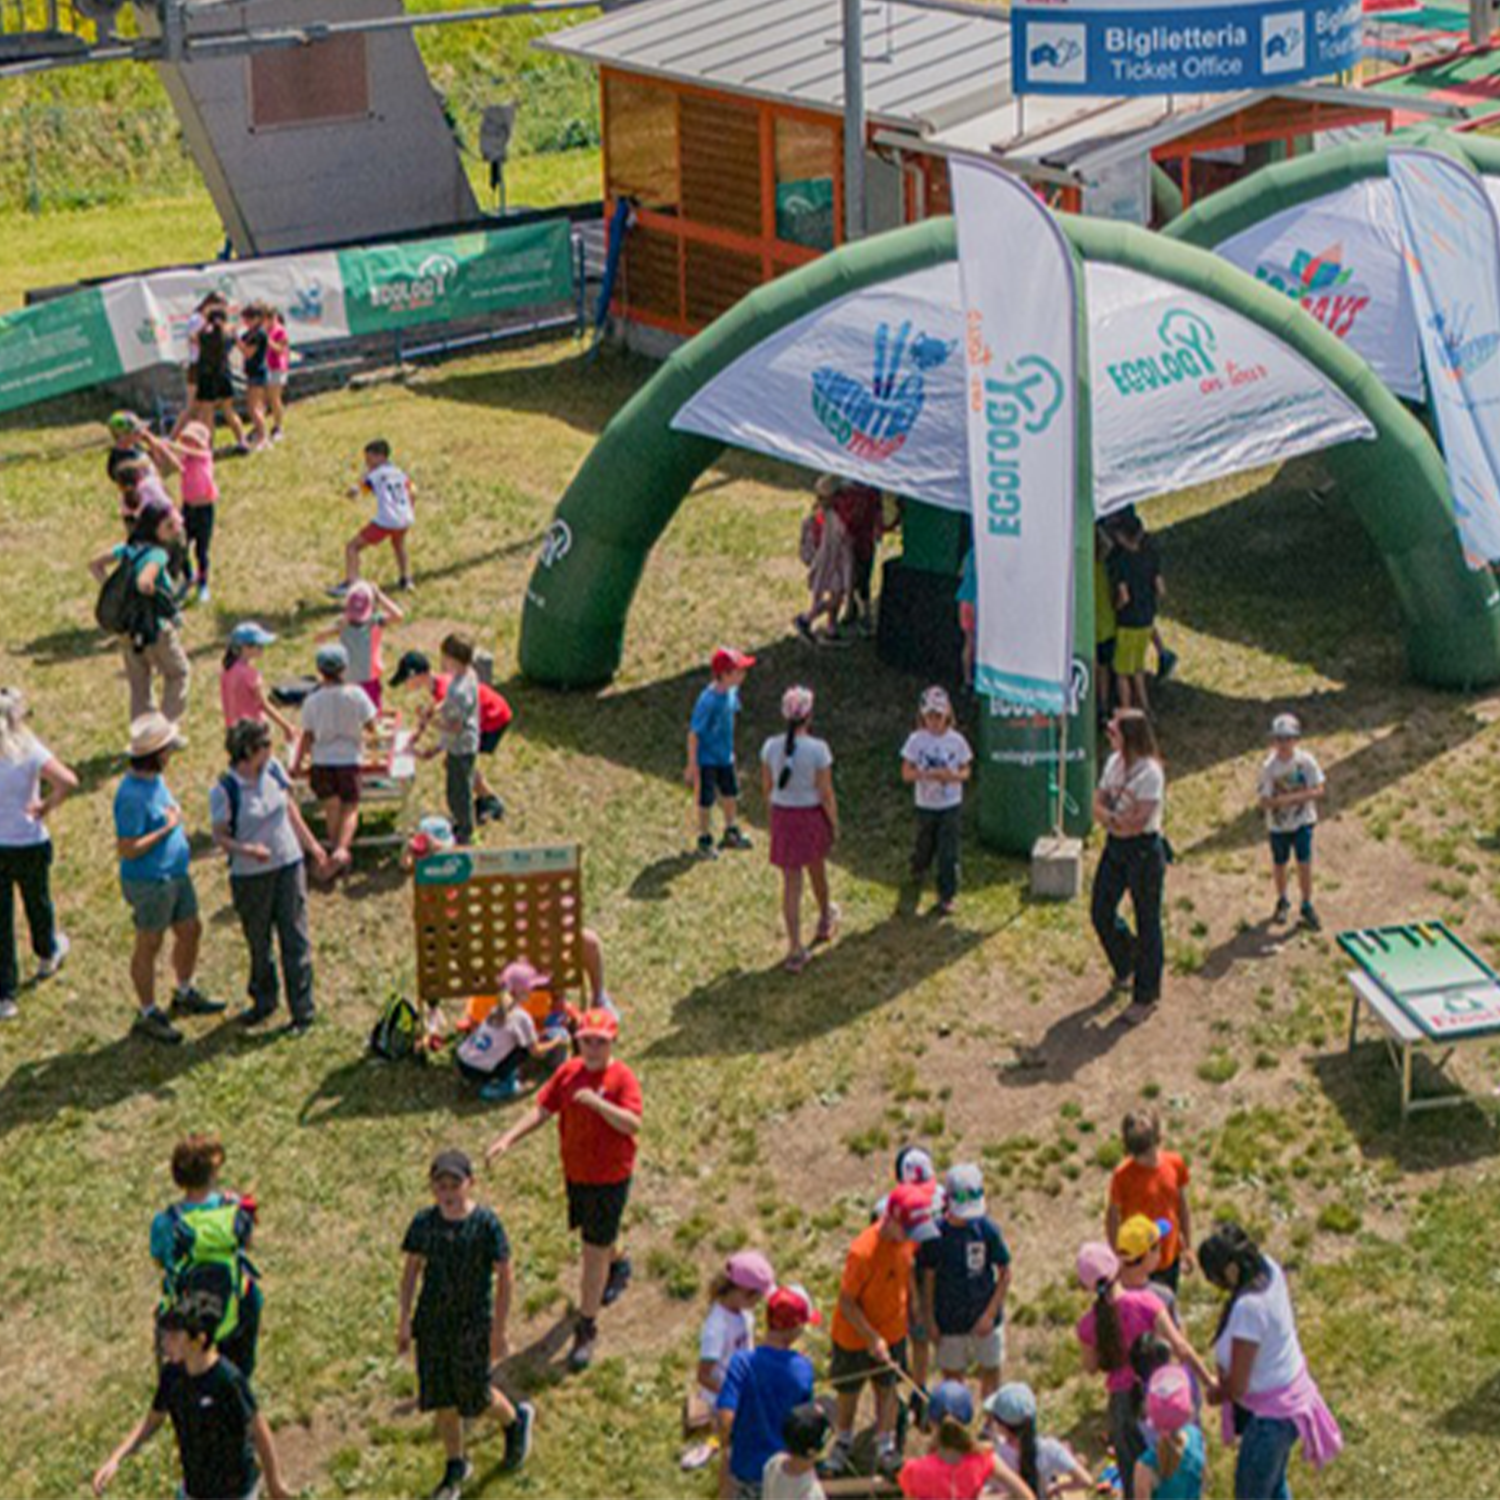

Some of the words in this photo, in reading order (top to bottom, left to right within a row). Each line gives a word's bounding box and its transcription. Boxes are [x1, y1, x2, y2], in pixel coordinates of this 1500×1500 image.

[1105, 22, 1247, 56] Biglietteria
[1111, 56, 1177, 82] Ticket
[1182, 53, 1243, 79] Office
[1106, 321, 1217, 397] ECOLOGY
